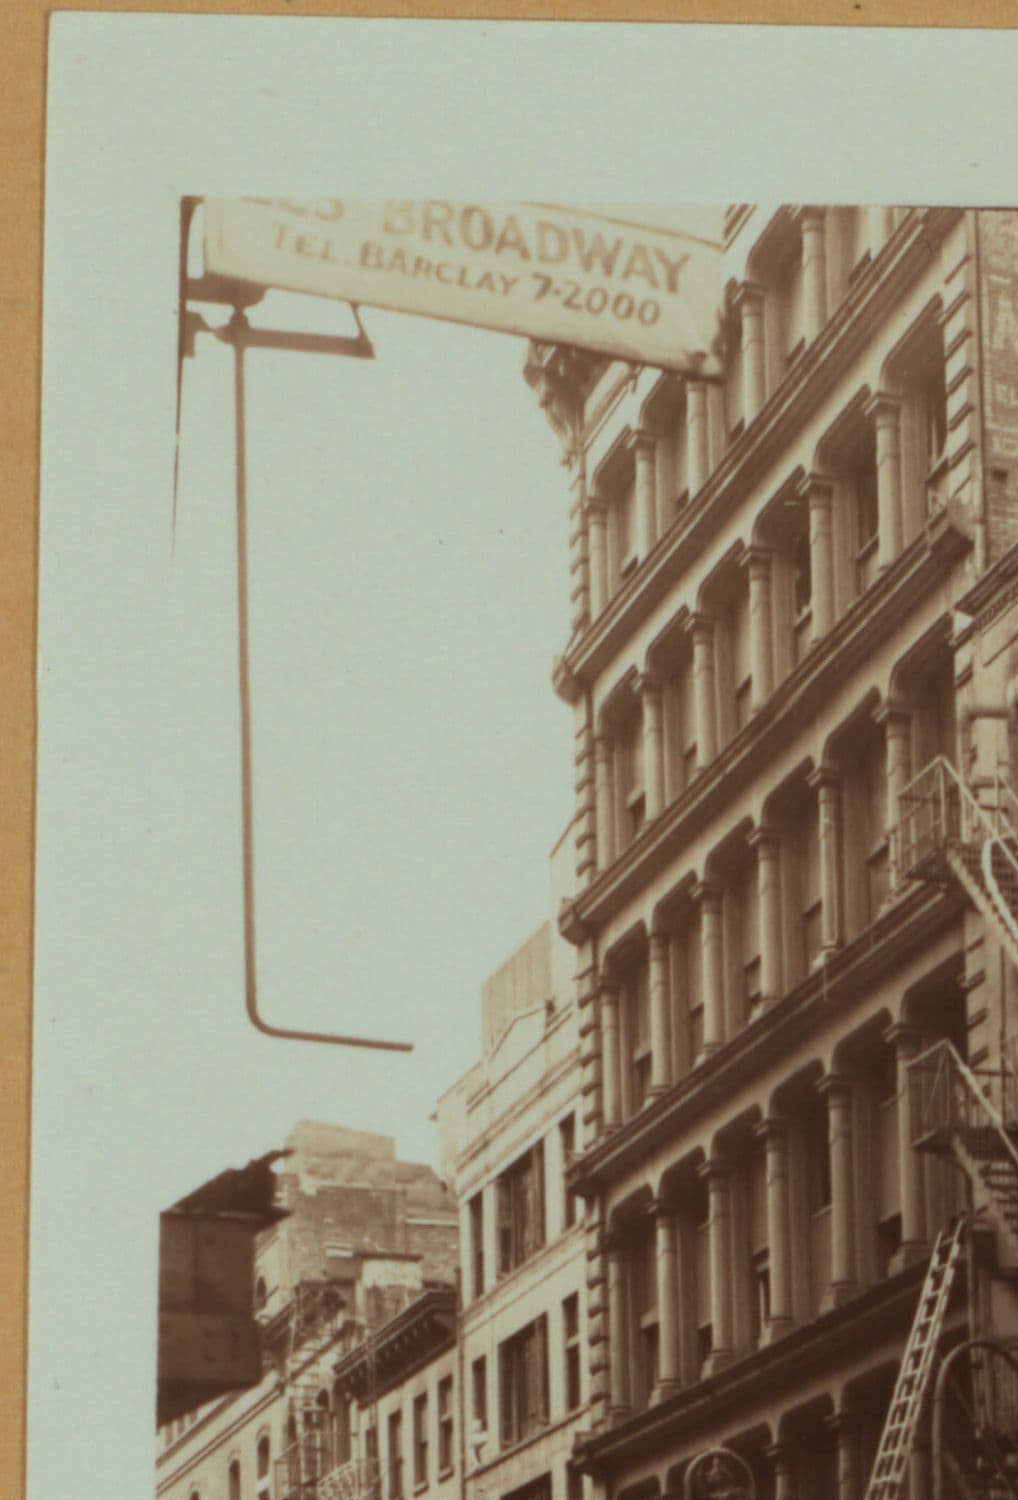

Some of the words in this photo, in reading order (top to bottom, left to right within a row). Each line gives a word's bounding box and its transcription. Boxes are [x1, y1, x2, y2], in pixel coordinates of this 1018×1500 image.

[359, 243, 520, 297] BARCLAY
[533, 274, 661, 326] 7-2000
[382, 200, 691, 294] BROADWAY
